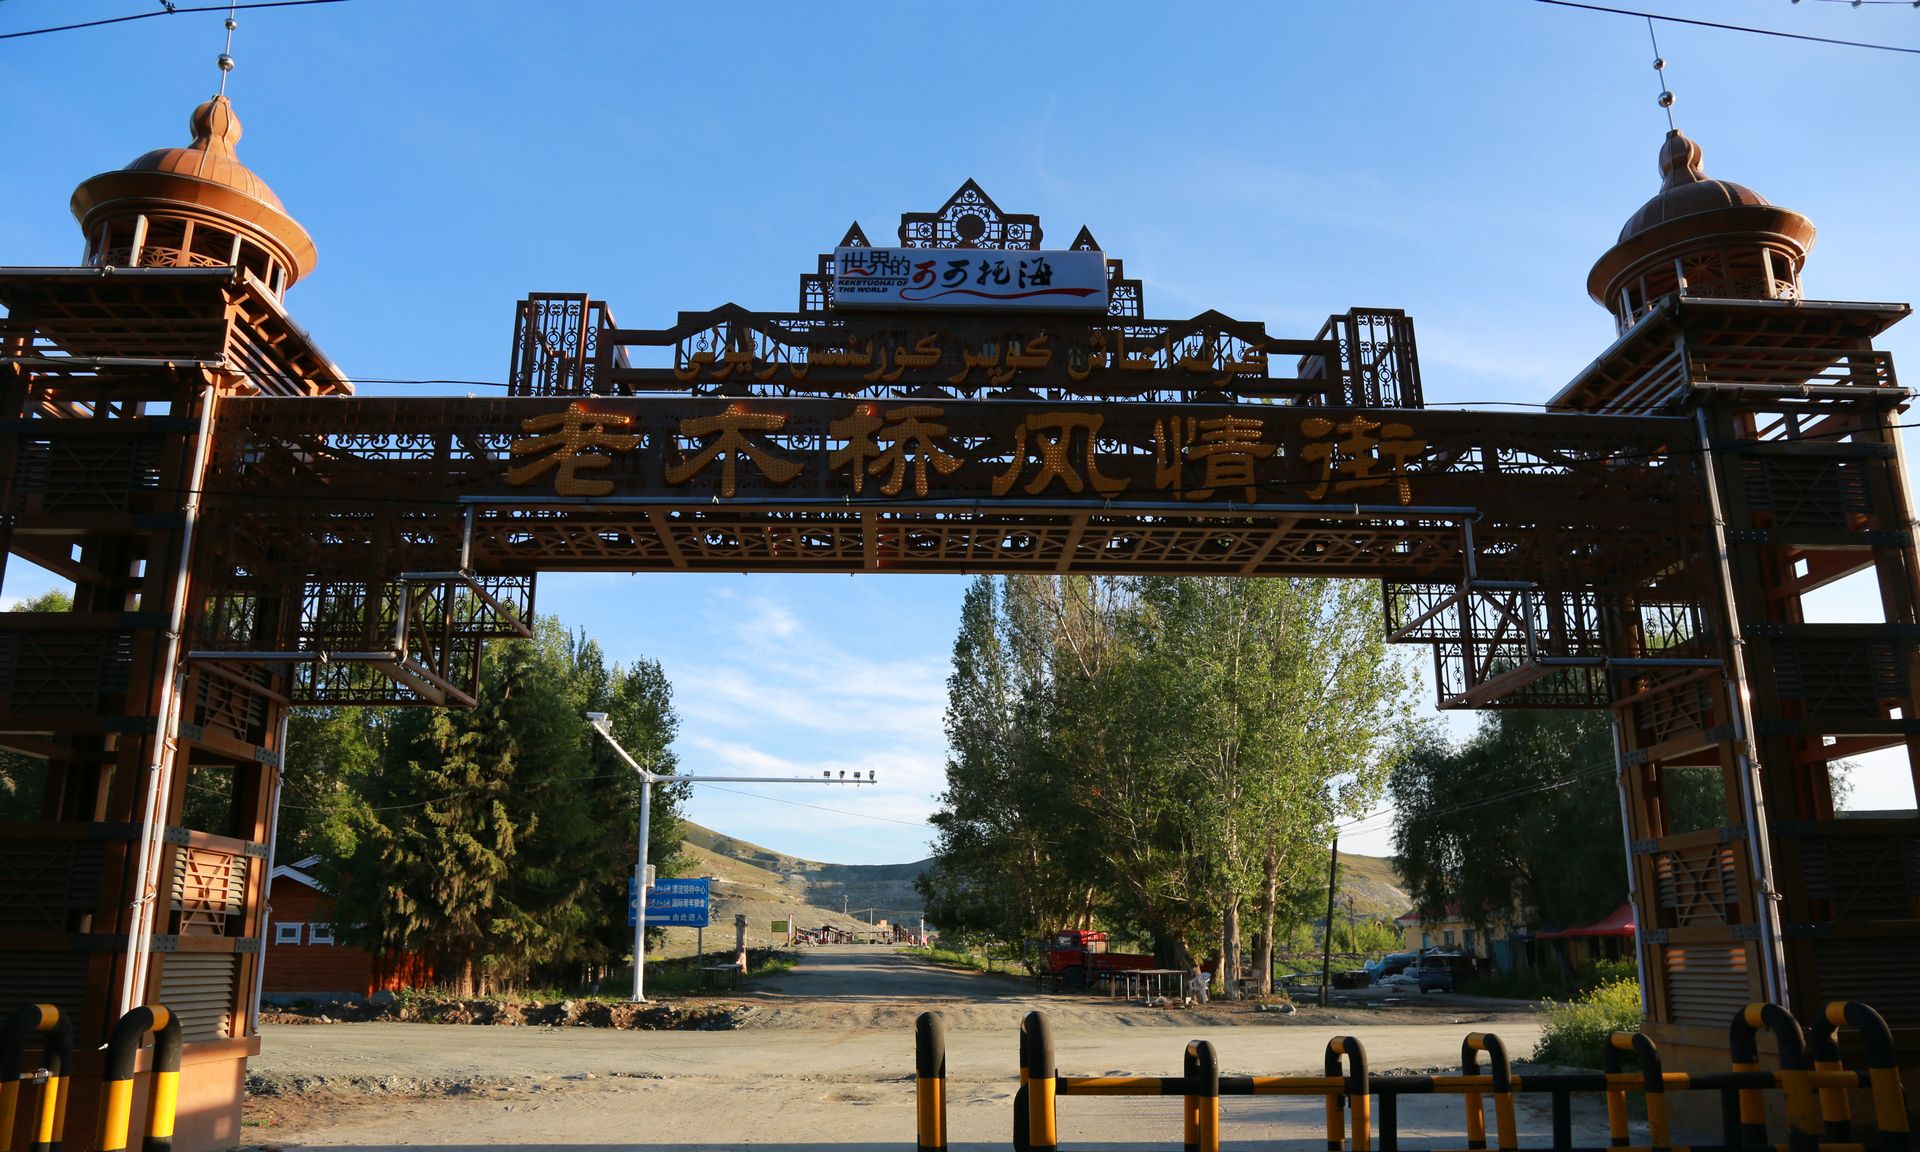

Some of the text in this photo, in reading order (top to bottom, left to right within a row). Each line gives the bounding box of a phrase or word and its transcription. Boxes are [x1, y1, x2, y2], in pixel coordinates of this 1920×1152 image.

[841, 251, 911, 276] 世界的
[505, 401, 1428, 506] 老木桥风情街
